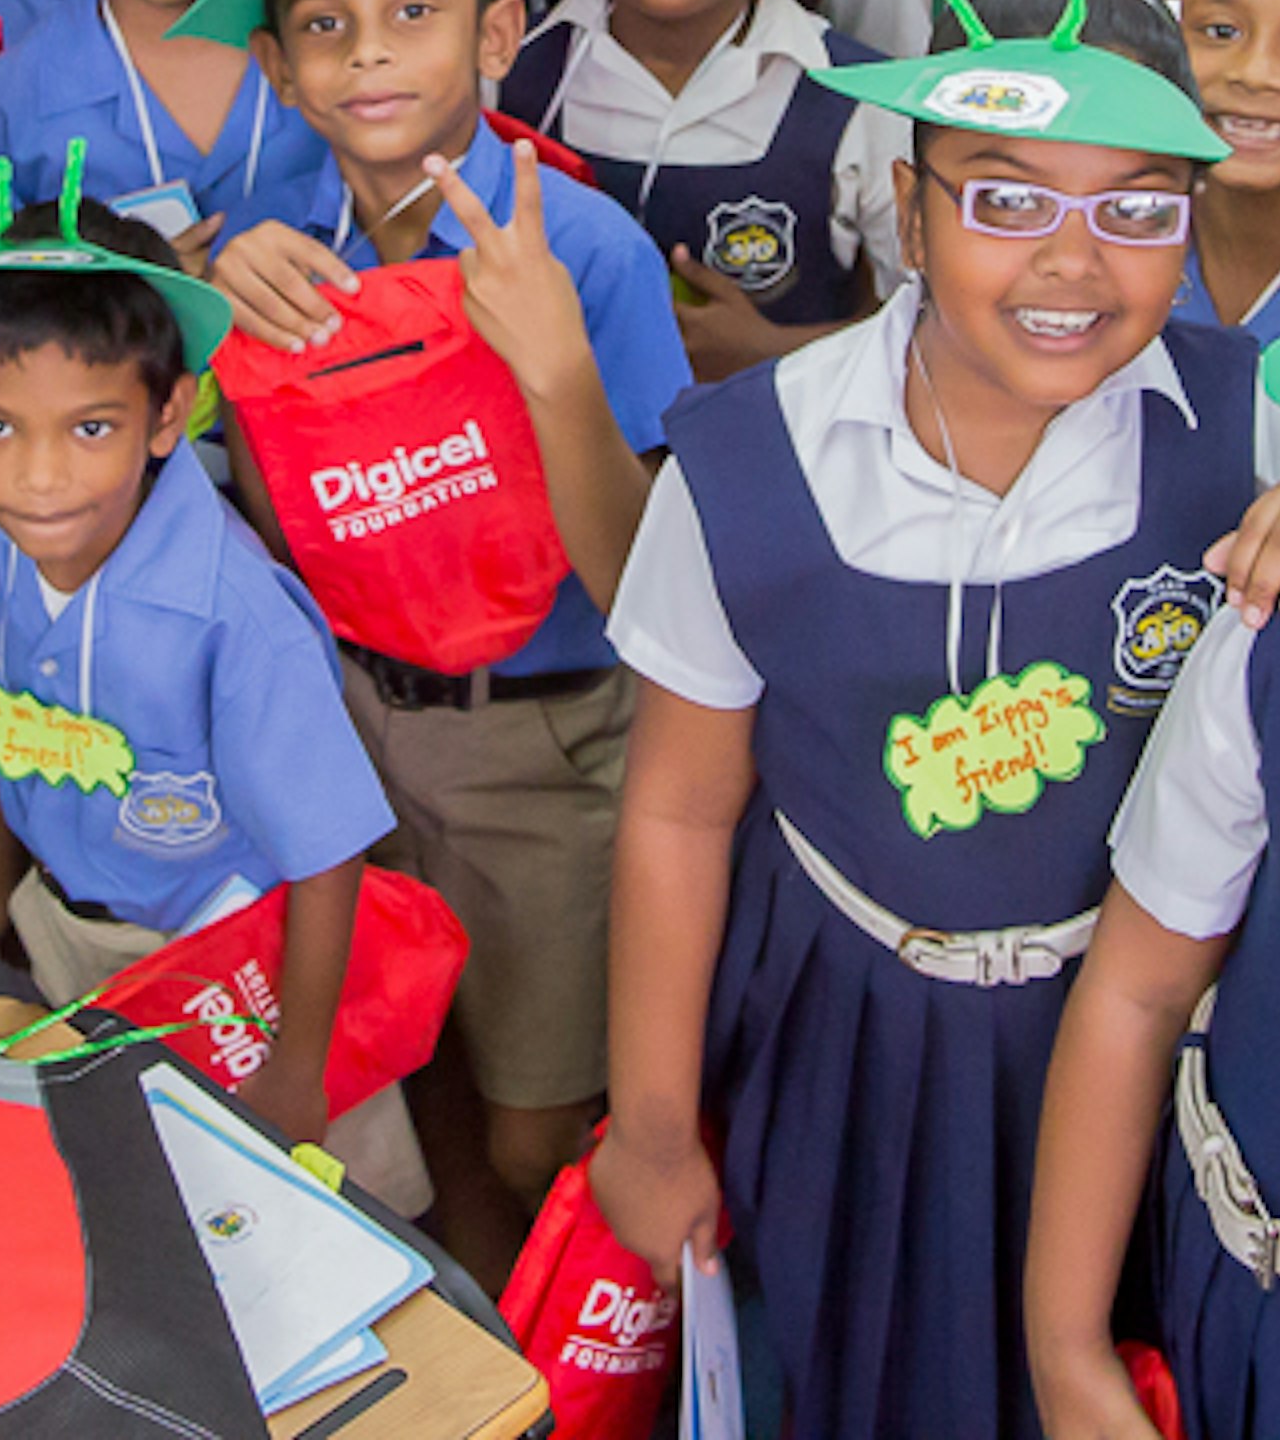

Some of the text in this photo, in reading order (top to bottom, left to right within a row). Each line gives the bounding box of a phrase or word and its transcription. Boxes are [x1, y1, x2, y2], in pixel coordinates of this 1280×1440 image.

[310, 418, 489, 510] Digicel
[331, 470, 499, 543] FOUNDATION
[895, 685, 1074, 767] I am Zippy's
[955, 731, 1050, 805] friend!
